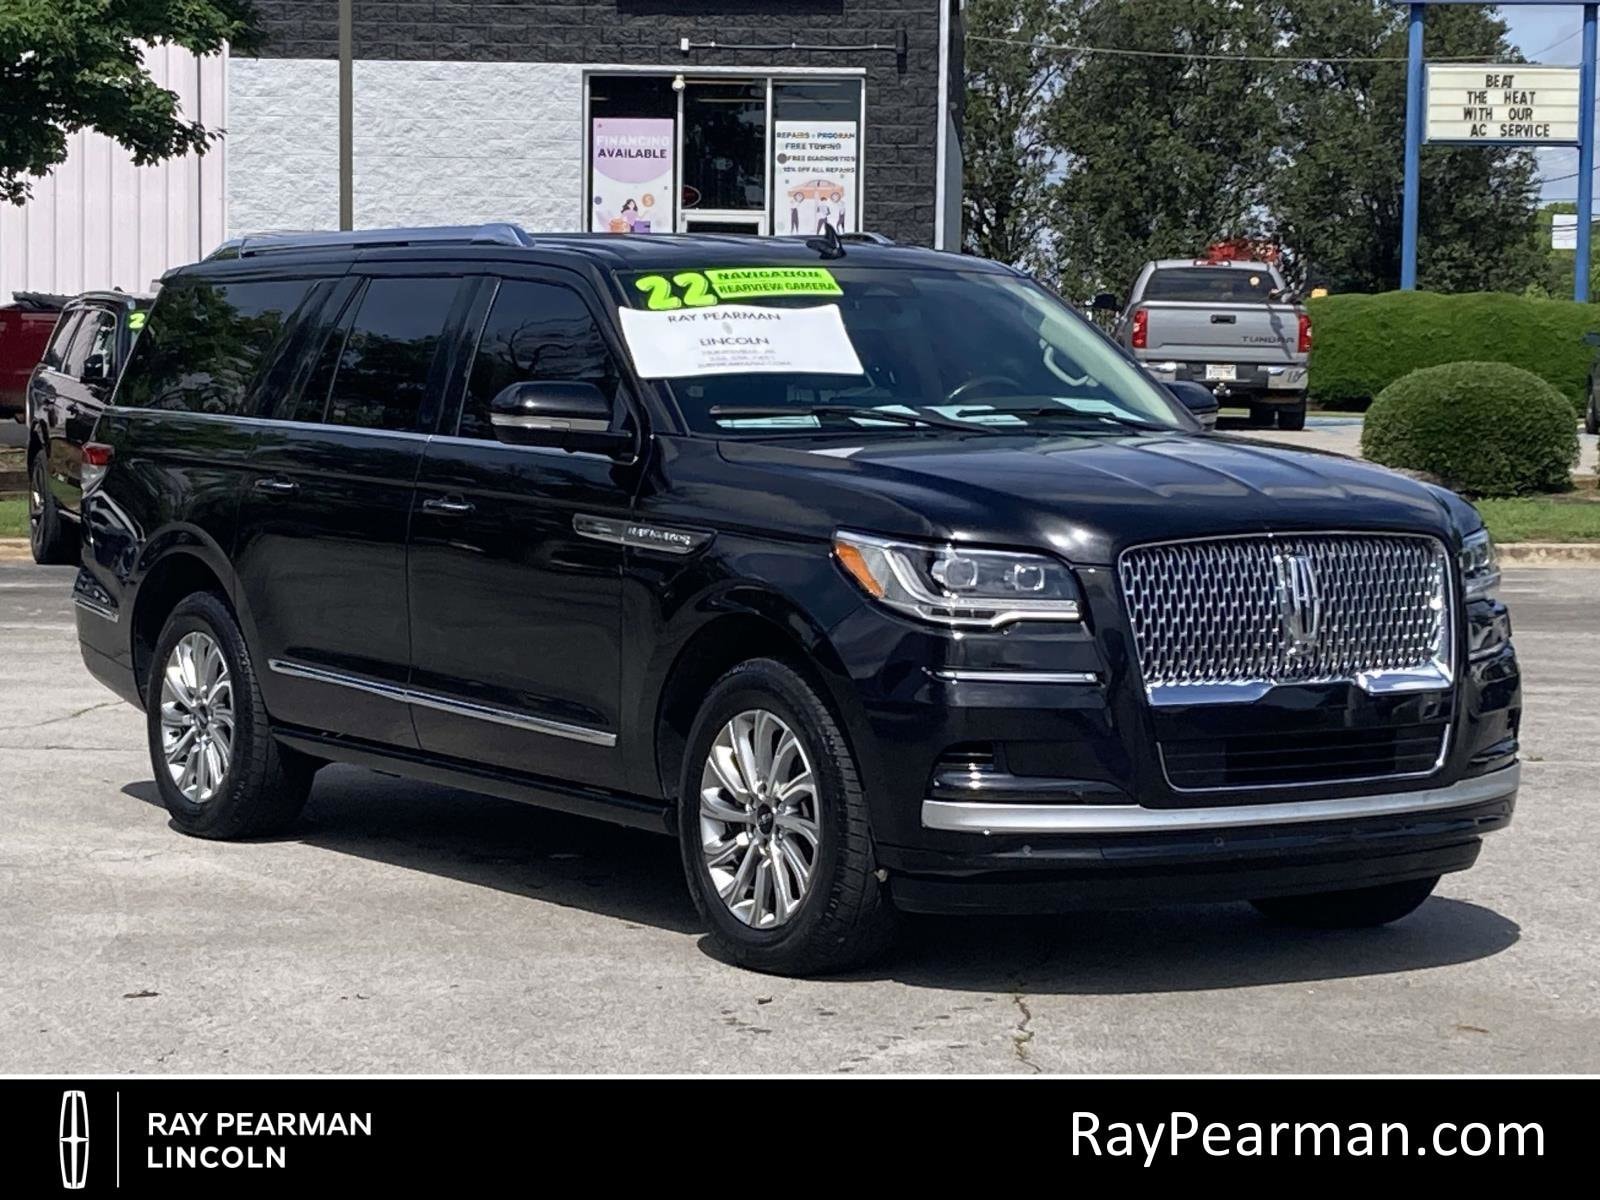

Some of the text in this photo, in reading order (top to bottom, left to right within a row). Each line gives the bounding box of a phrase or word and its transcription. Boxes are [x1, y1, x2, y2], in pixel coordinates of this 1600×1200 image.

[1485, 74, 1515, 88] BEAT
[1467, 91, 1536, 105] THE HEAT
[1463, 107, 1533, 121] WITH OUR
[776, 131, 810, 139] REPAIRS
[1470, 124, 1550, 138] AC SERVICE
[596, 134, 670, 147] FINANCING
[785, 142, 842, 150] FREE TOWING
[597, 148, 667, 159] AVAILABLE
[635, 270, 822, 311] 22 NAVIGATION
[718, 282, 837, 294] REARVIEW CAMERA
[668, 311, 782, 324] RAY PEARMAN
[699, 336, 770, 347] LINCOLN
[1242, 335, 1296, 344] TUNDRA
